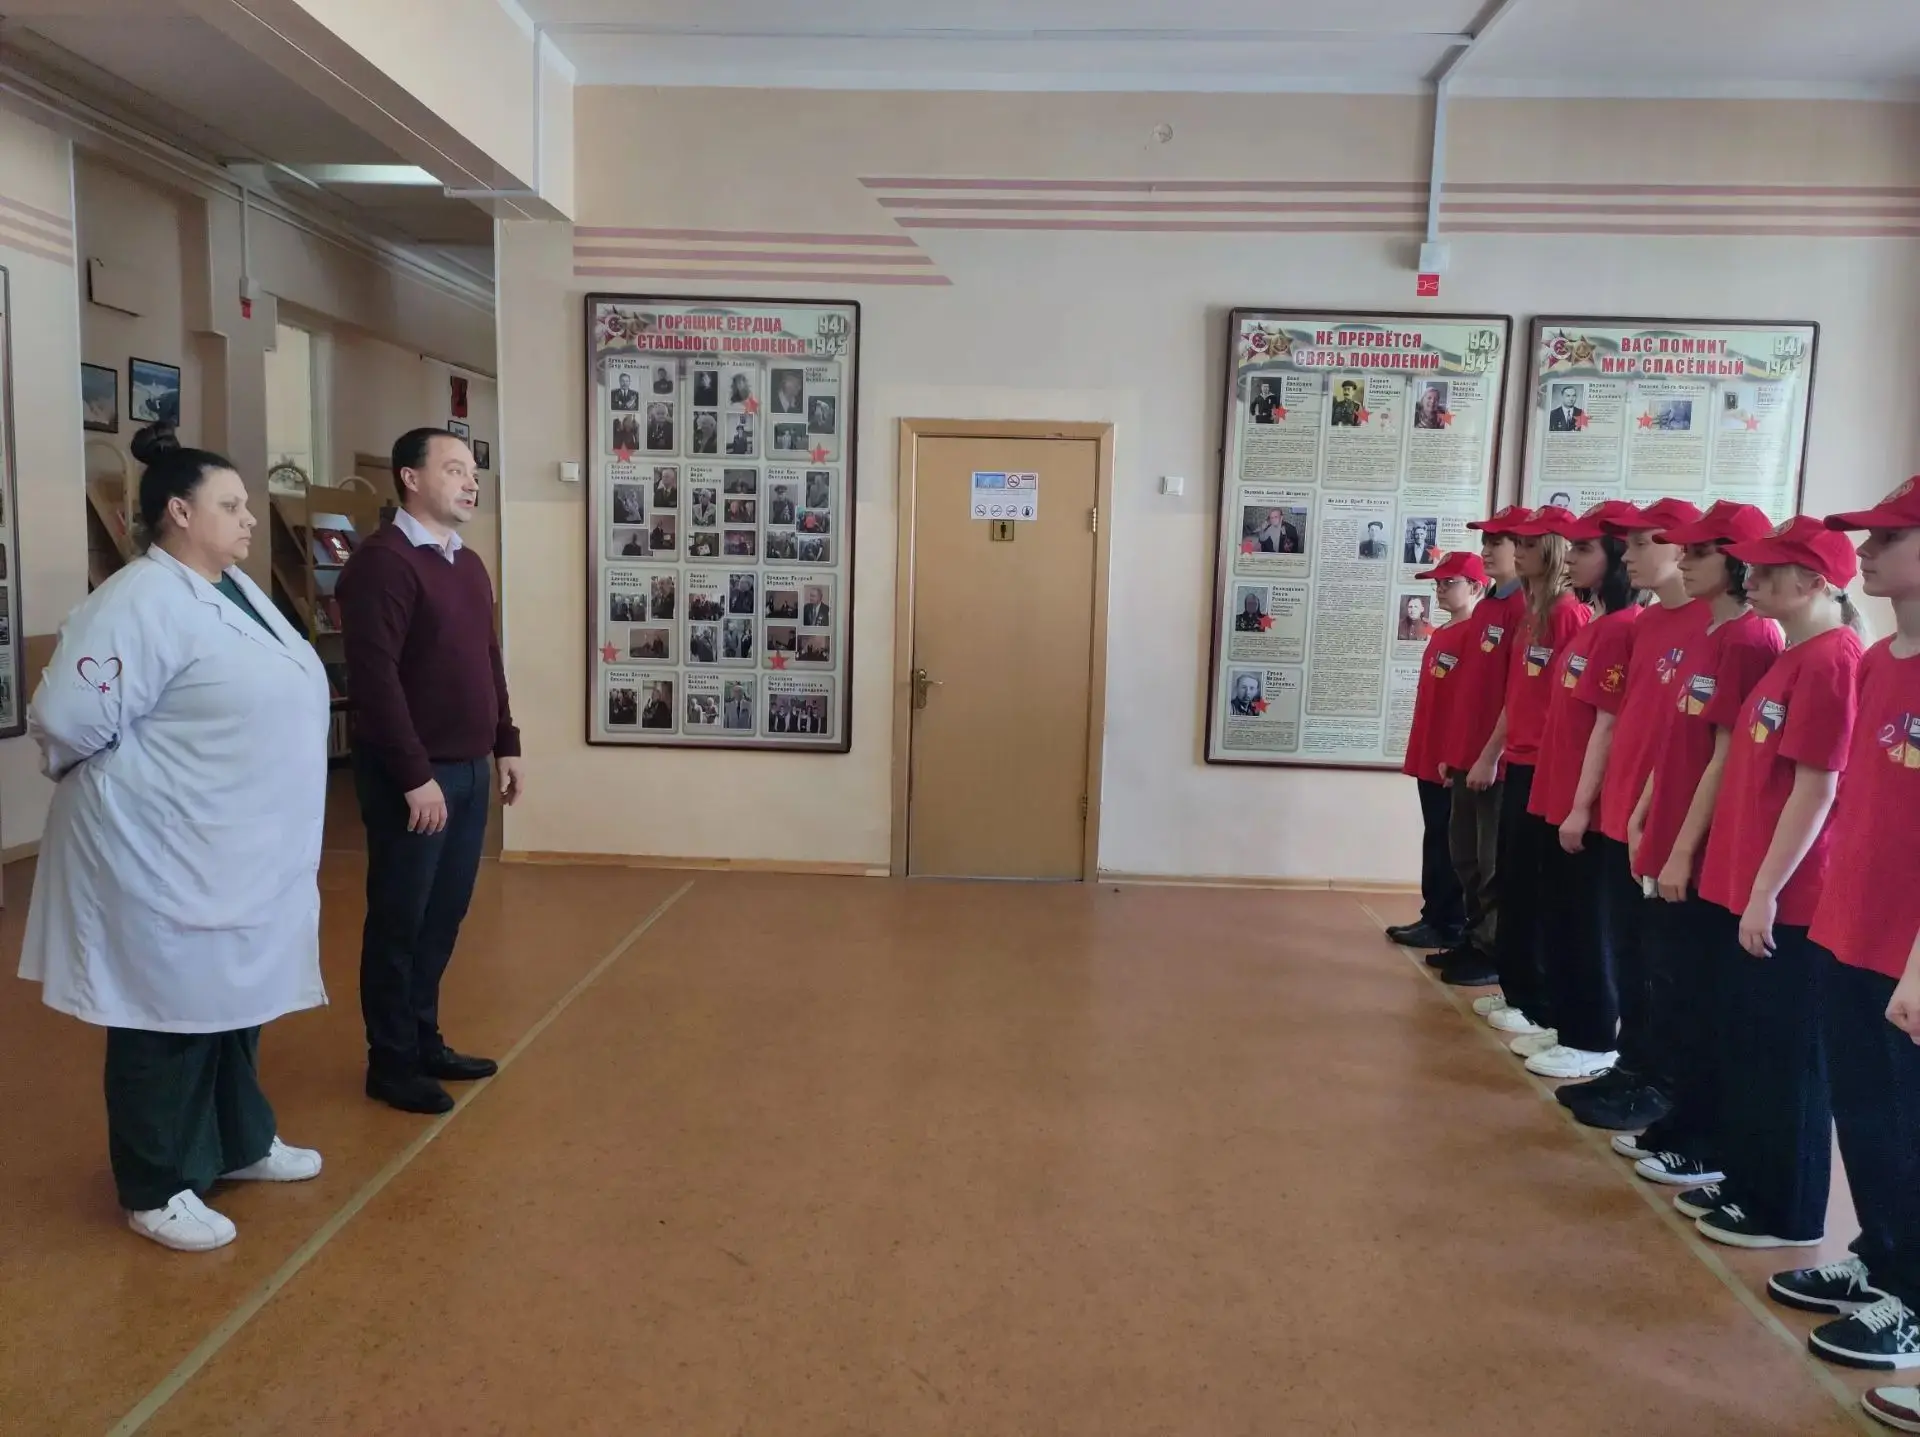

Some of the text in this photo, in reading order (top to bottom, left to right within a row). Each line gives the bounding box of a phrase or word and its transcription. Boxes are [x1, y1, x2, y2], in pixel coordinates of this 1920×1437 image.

[657, 314, 783, 334] ГОРЯЩИЕ СЕРДЦА
[636, 334, 806, 354] СТАЛЬНОГО ПОКОЛЕНЬЯ
[1315, 330, 1422, 348] НЕ ПРЕРВЁТСЯ
[1621, 337, 1727, 354] ВАС ПОМНИТ
[1295, 350, 1440, 369] СВЯЗЬ ПОКОЛЕНИЙ
[1601, 357, 1744, 375] МИР СПАСЁННЫЙ
[1880, 723, 1896, 744] 2
